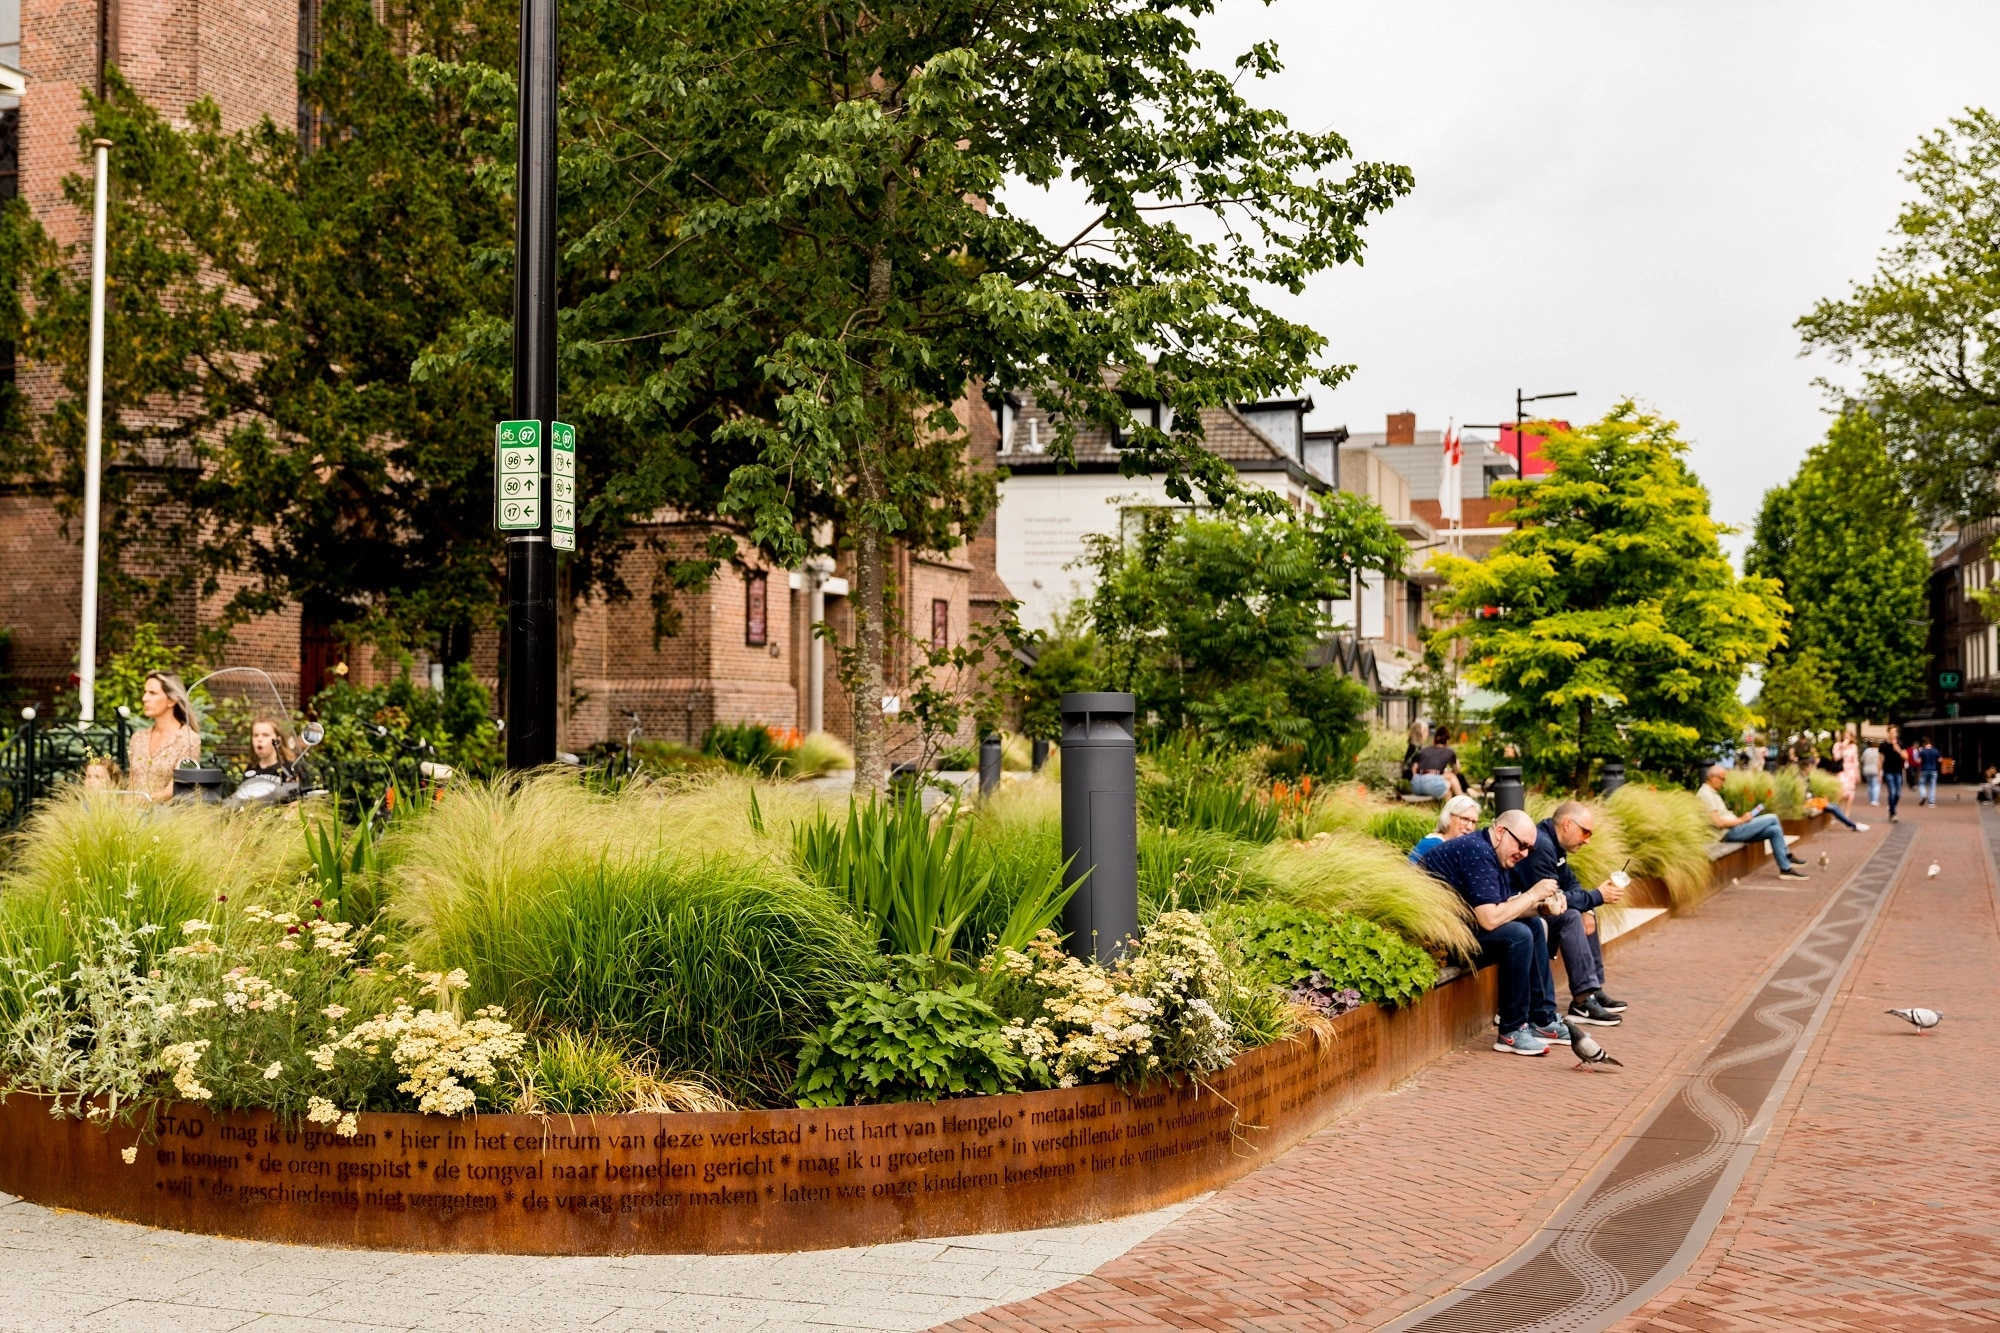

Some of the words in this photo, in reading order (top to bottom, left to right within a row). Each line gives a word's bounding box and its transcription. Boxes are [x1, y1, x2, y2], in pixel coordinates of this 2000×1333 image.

[522, 431, 532, 440] 97
[508, 456, 518, 465] 96
[507, 482, 518, 490] 50
[557, 484, 563, 492] 50
[508, 508, 517, 516] 17
[557, 509, 562, 518] 17
[157, 1116, 203, 1138] STAD
[221, 1127, 257, 1148] mag
[264, 1123, 280, 1143] ik
[401, 1129, 440, 1150] hier
[448, 1131, 466, 1150] in
[474, 1130, 505, 1150] het
[513, 1132, 600, 1150] centrum
[608, 1132, 645, 1148] van
[653, 1128, 704, 1148] deze
[710, 1124, 800, 1147] werkstad
[826, 1122, 855, 1142] het
[862, 1120, 897, 1140] hart
[903, 1120, 935, 1136] van
[942, 1110, 1013, 1136] Hengelo
[1031, 1098, 1105, 1124] metaalstad
[1110, 1098, 1121, 1113] in
[1127, 1091, 1166, 1111] Twente
[157, 1148, 175, 1165] en
[181, 1147, 238, 1169] komen
[259, 1153, 281, 1173] de
[288, 1157, 330, 1175] oren
[338, 1157, 411, 1181] gespitst
[435, 1159, 460, 1179] de
[467, 1159, 543, 1185] tongval
[552, 1162, 598, 1179] naar
[606, 1159, 695, 1180] beneden
[704, 1156, 774, 1182] gericht
[798, 1155, 839, 1175] mag
[847, 1150, 863, 1170] ik
[870, 1154, 881, 1167] u
[888, 1148, 955, 1172] groeten
[962, 1141, 993, 1161] hier
[1013, 1138, 1027, 1155] in
[1032, 1121, 1123, 1153] verschillende
[1127, 1119, 1154, 1138] talen
[1166, 1108, 1205, 1130] verhalen
[212, 1179, 233, 1198] de
[239, 1183, 358, 1207] geschiedenis
[366, 1188, 402, 1211] niet
[409, 1189, 497, 1214] vergeten
[523, 1190, 548, 1209] de
[556, 1194, 613, 1214] vraag
[621, 1192, 683, 1214] groter
[689, 1186, 757, 1206] maken
[783, 1183, 830, 1202] laten
[837, 1185, 865, 1199] we
[872, 1178, 917, 1197] onze
[924, 1171, 998, 1193] kinderen
[1005, 1162, 1075, 1184] koesteren
[1091, 1153, 1116, 1172] hier
[1120, 1149, 1135, 1166] de
[1138, 1138, 1178, 1163] vrijheid
